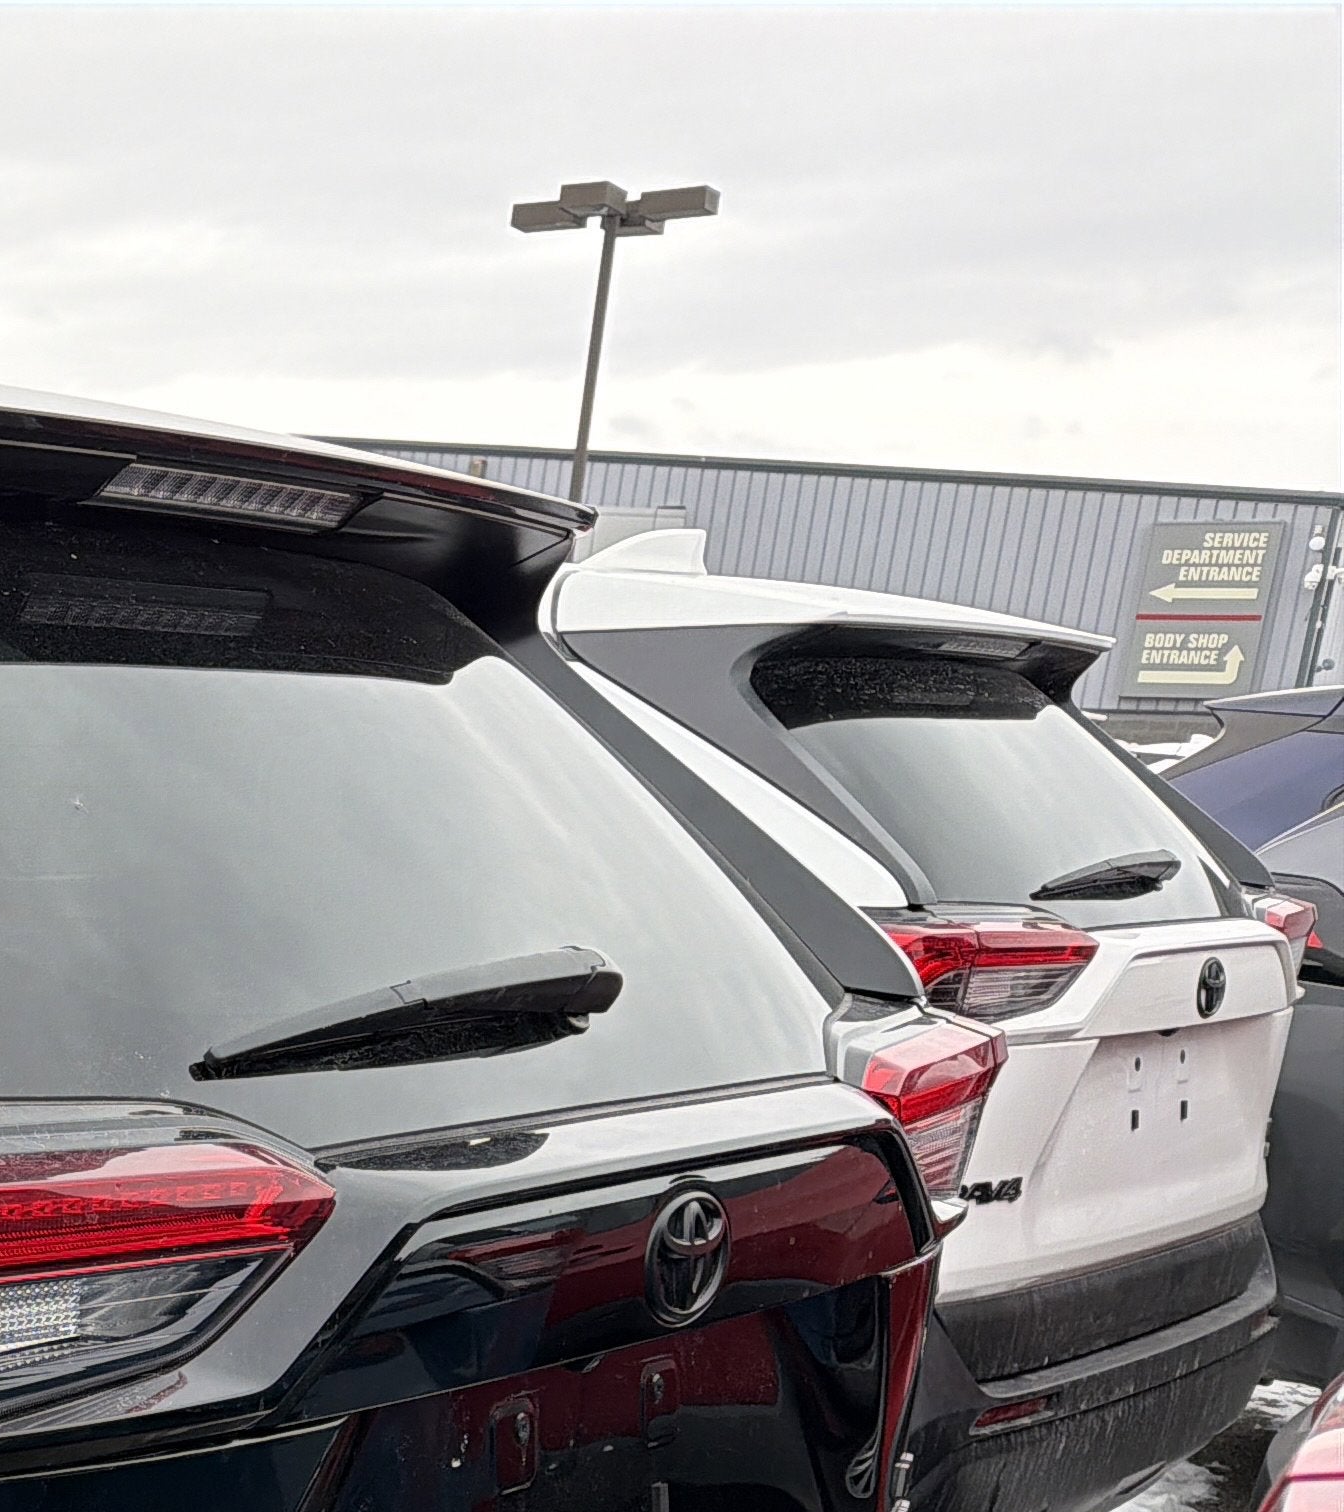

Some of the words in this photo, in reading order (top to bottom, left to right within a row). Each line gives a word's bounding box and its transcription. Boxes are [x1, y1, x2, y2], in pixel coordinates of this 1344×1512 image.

[1202, 531, 1269, 548] SERVICE
[1161, 549, 1266, 565] DEPARTMENT
[1178, 566, 1262, 582] ENTRANCE
[1144, 633, 1185, 648] BODY
[1187, 633, 1229, 648] SHOP
[1141, 649, 1219, 665] ENTRANCE
[958, 1176, 1024, 1206] AV4
